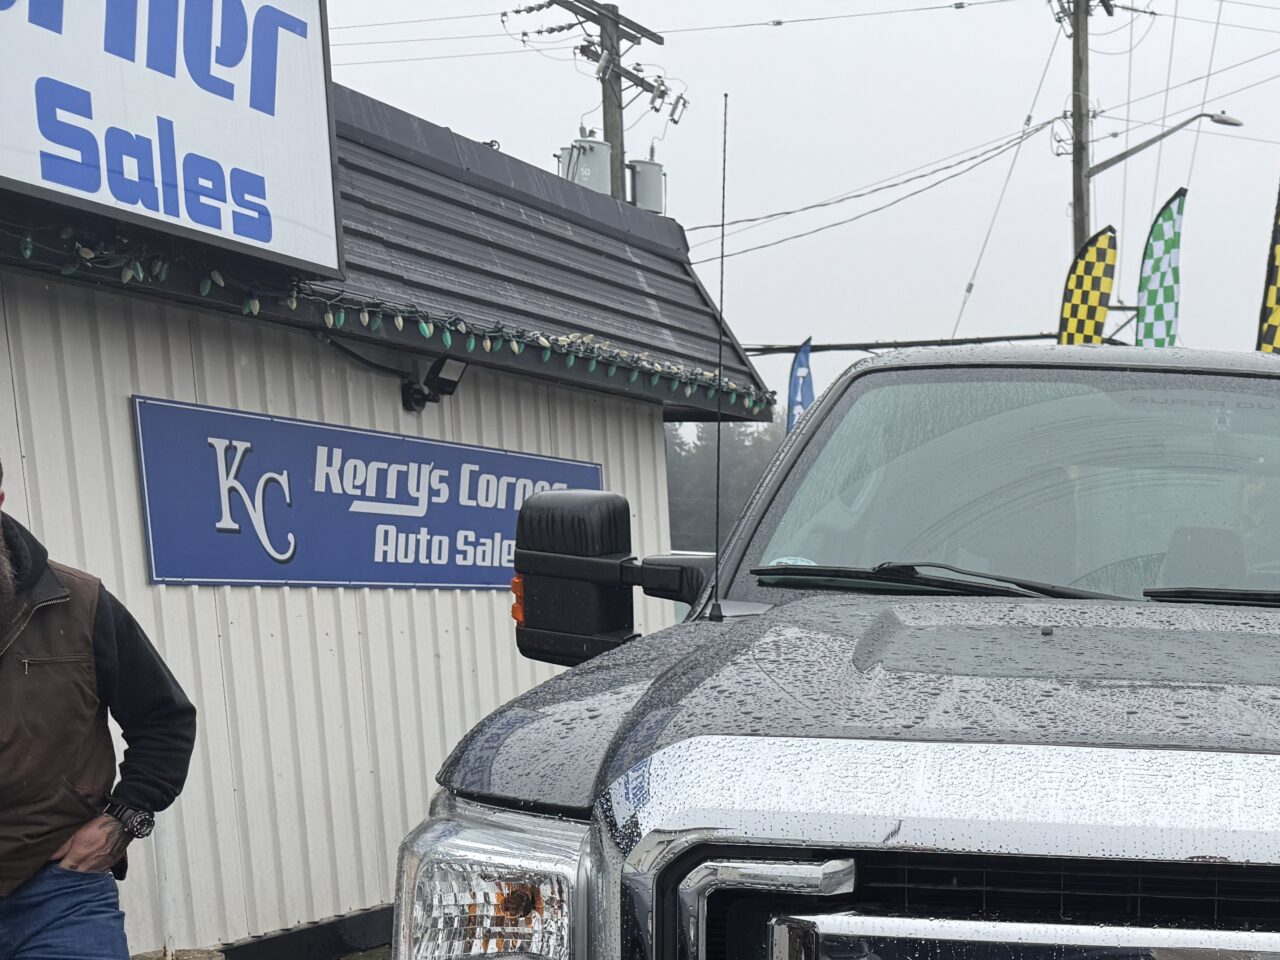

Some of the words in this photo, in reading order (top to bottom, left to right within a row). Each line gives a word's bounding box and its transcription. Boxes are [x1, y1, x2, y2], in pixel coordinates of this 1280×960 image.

[34, 76, 273, 244] Sales
[207, 437, 295, 562] KC
[459, 463, 568, 511] Corn
[374, 524, 449, 566] Auto
[455, 530, 516, 568] Sale
